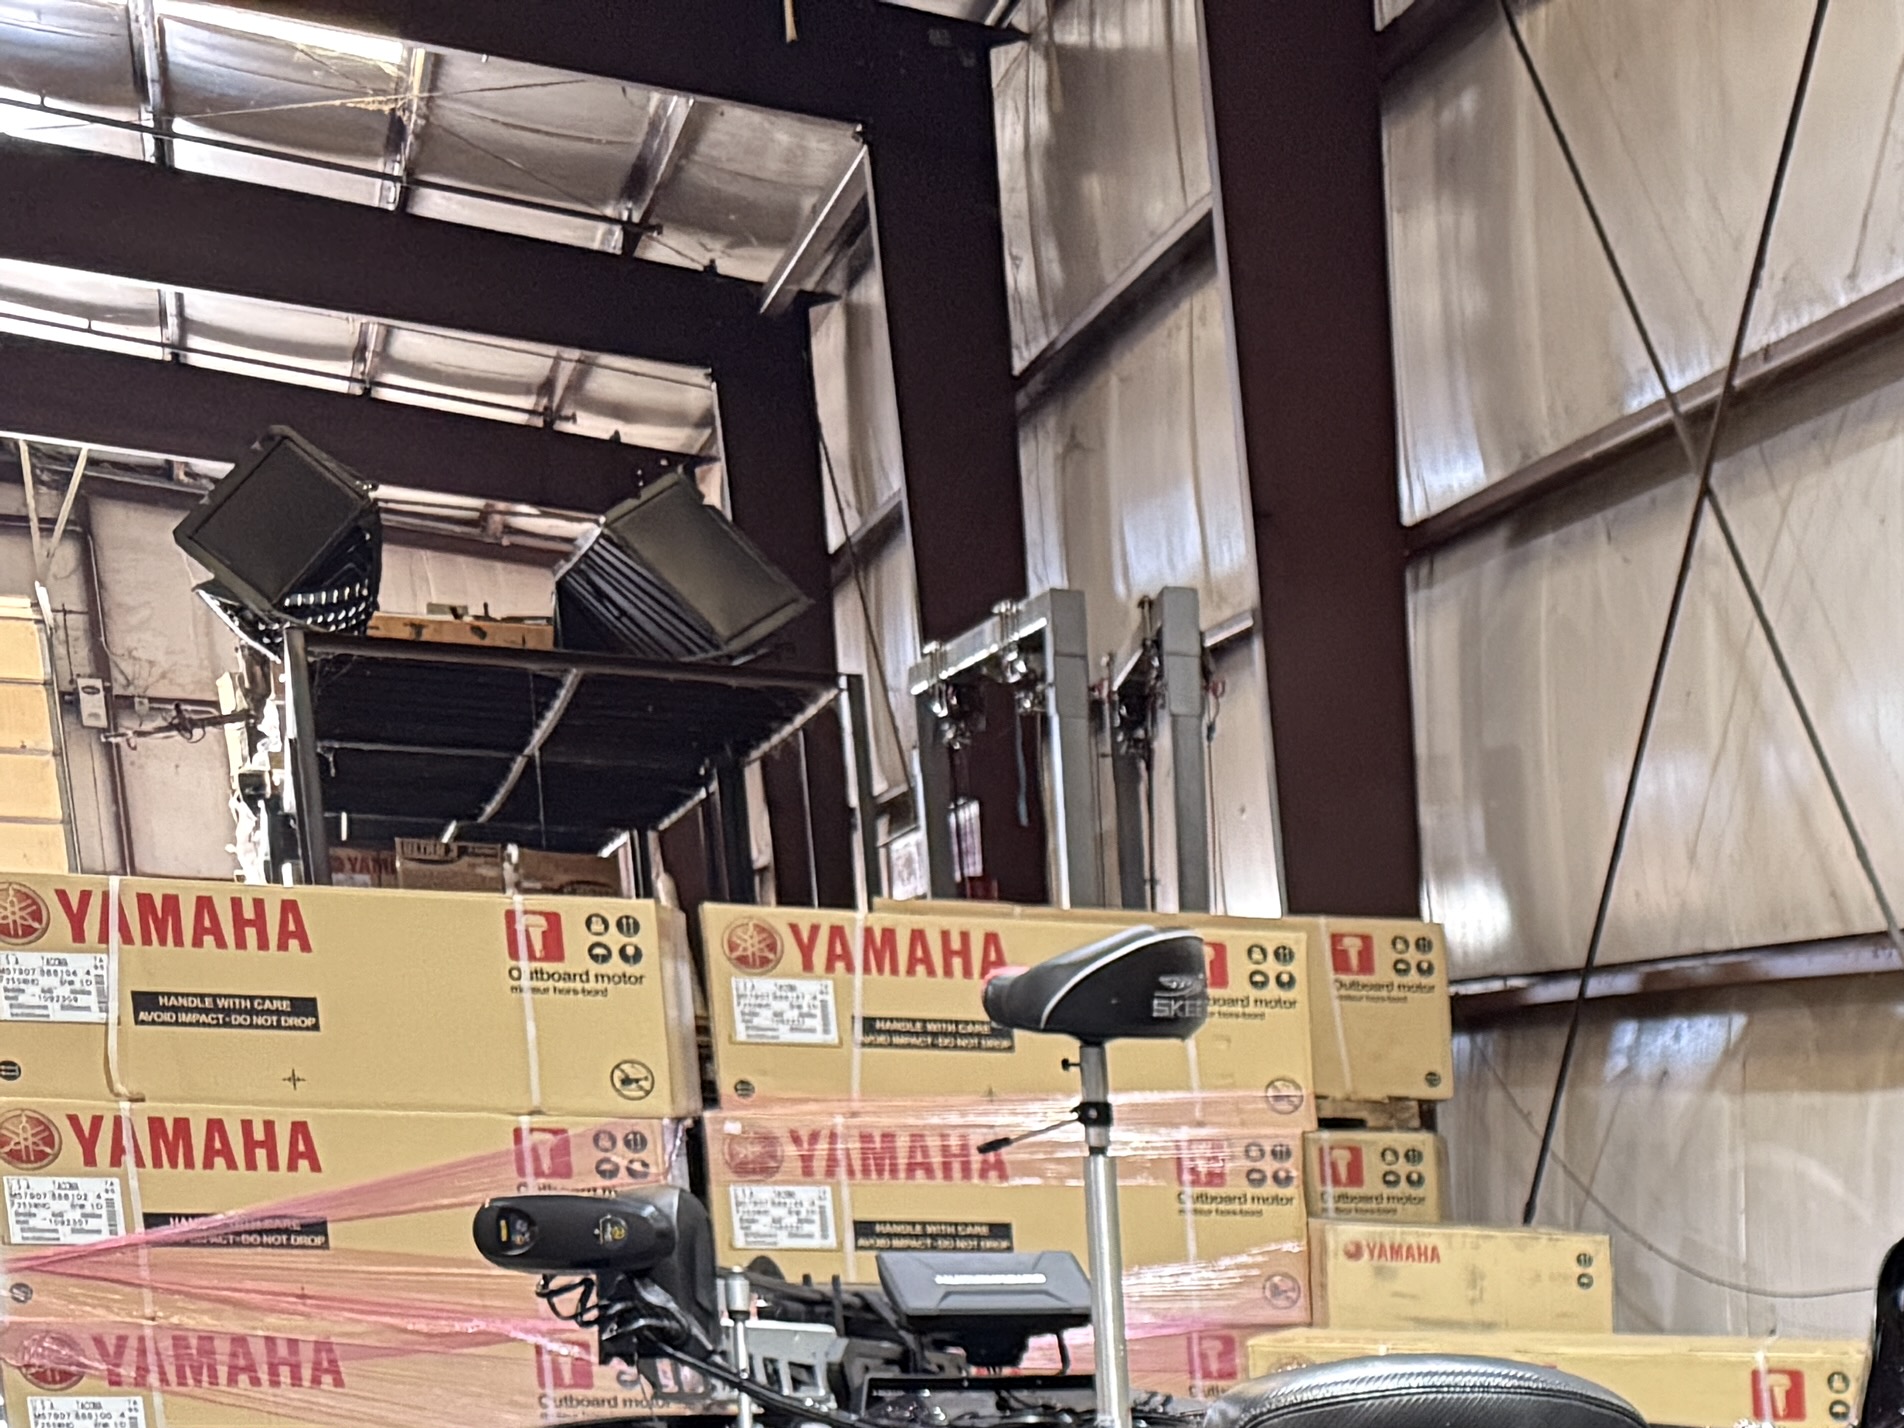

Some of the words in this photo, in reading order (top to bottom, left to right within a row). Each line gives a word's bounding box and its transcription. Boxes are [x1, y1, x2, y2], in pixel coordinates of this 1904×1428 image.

[55, 887, 313, 953] YAMAHA
[789, 922, 1010, 981] YAMAHA
[508, 967, 590, 984] Otboard
[594, 971, 645, 986] motor
[159, 995, 214, 1009] HANDLE
[217, 997, 250, 1010] WITH
[254, 999, 291, 1011] CARE
[1254, 996, 1297, 1009] motor
[138, 1011, 176, 1022] AVOID
[178, 1012, 224, 1024] IMPACT
[231, 1015, 250, 1025] DO
[253, 1015, 278, 1026] NOT
[281, 1016, 316, 1027] DROP
[66, 1113, 324, 1174] YAMAHA
[791, 1128, 1010, 1182] YAMAHA
[1251, 1193, 1295, 1207] motor
[262, 1234, 288, 1245] NOT
[291, 1234, 325, 1246] DROP
[1366, 1240, 1441, 1264] YAMAHA
[92, 1335, 347, 1390] YAMAHA
